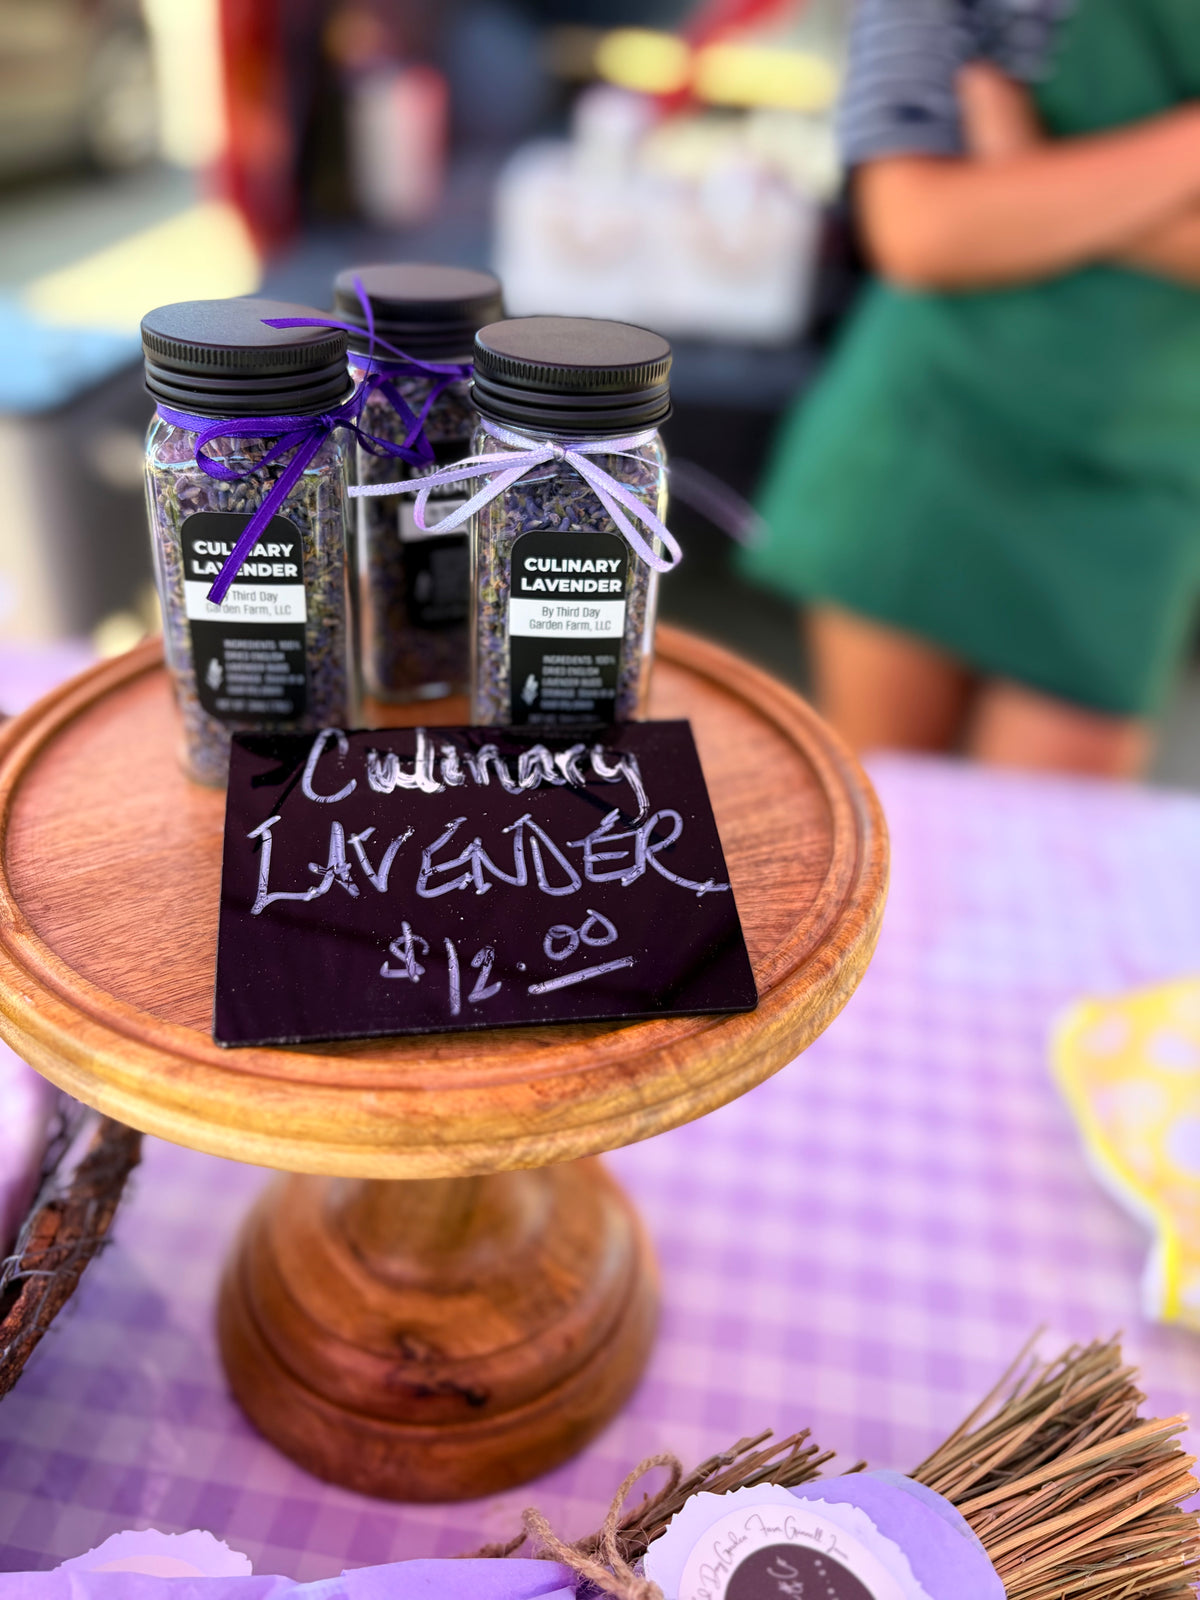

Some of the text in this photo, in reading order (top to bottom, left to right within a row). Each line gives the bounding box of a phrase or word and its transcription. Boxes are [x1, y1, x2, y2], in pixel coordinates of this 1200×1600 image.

[193, 540, 294, 557] CULARY
[523, 557, 622, 573] CULINARY
[520, 577, 623, 593] LAVENDER
[232, 590, 257, 601] Third
[260, 591, 279, 604] Day
[274, 605, 292, 616] LLC
[541, 606, 601, 619] By Third Day
[529, 619, 612, 632] Garden Farm, LLC
[302, 727, 650, 826] Culinary
[247, 808, 731, 914] LAVENDER
